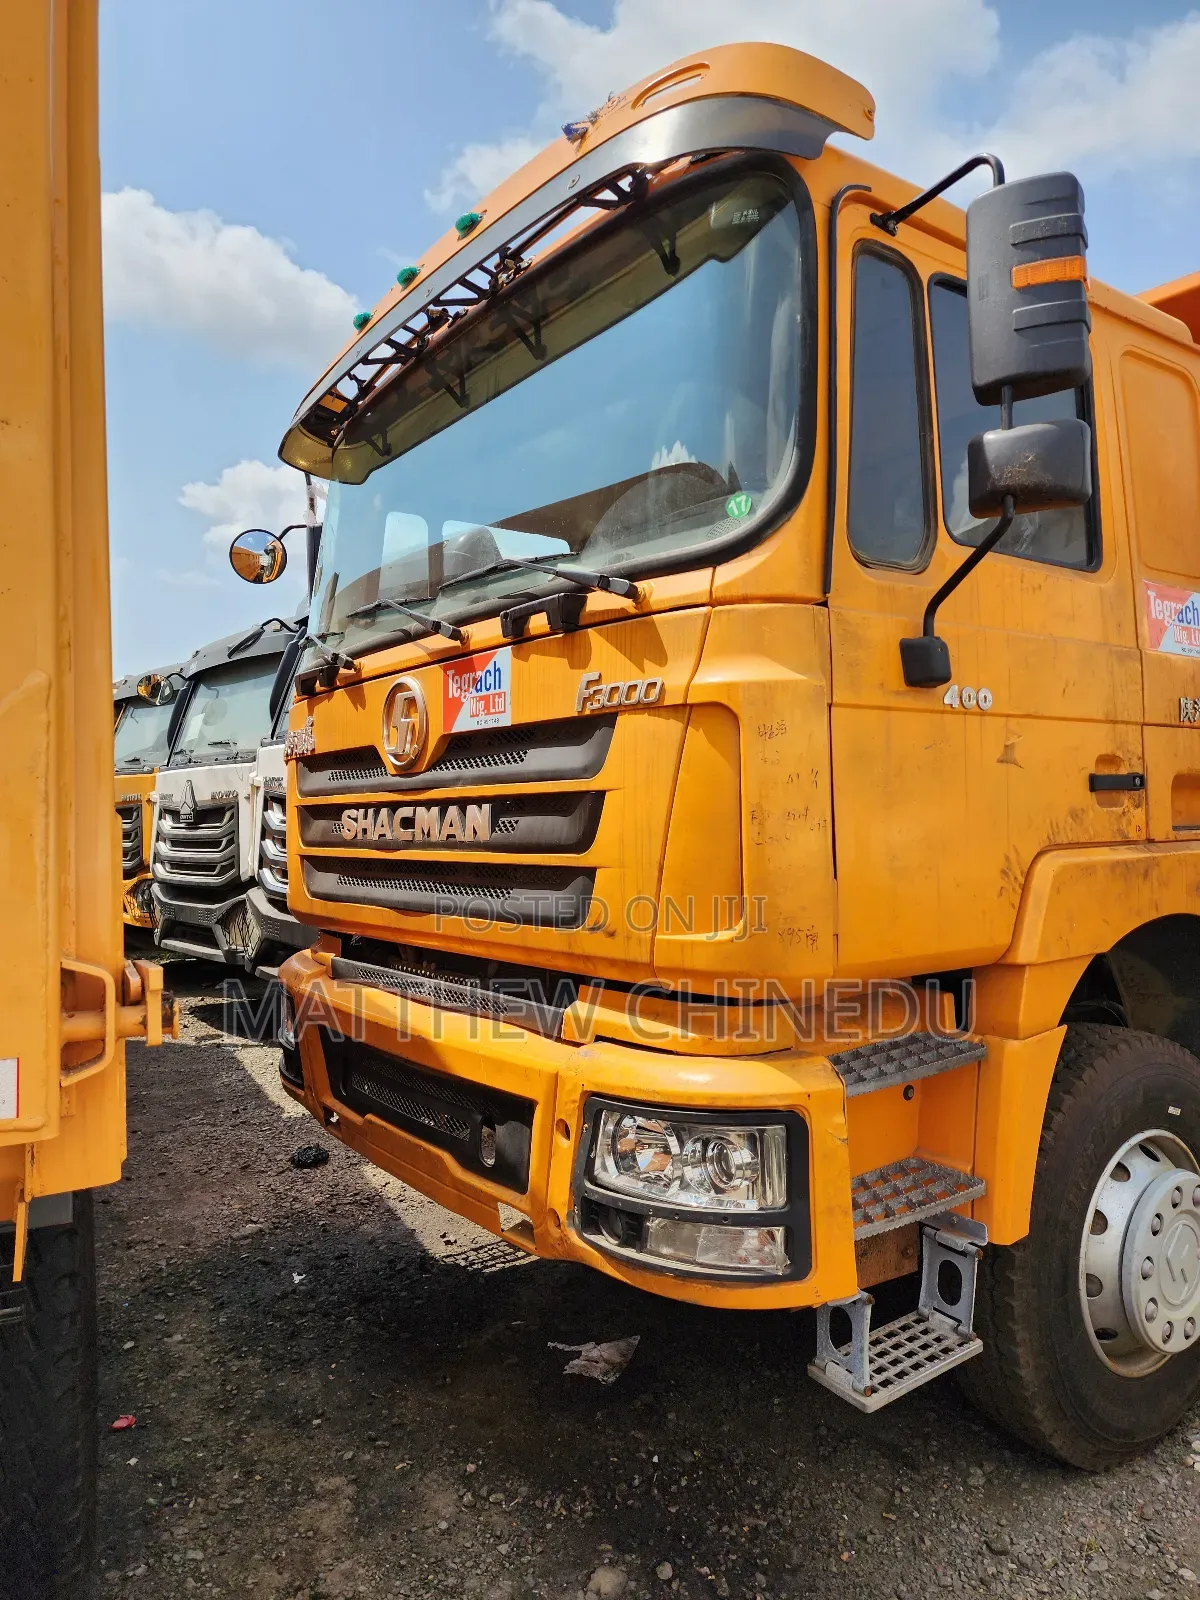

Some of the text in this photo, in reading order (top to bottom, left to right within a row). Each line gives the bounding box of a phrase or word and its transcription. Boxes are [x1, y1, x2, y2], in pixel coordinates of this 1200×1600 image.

[728, 494, 747, 516] 17
[1147, 589, 1200, 627] Tegrach
[1173, 625, 1190, 645] Nig.
[447, 660, 502, 703] Tegrach
[575, 671, 664, 712] F3000
[943, 684, 993, 711] 400
[470, 692, 505, 717] Nig. Ltd
[341, 803, 493, 842] SHACMAN
